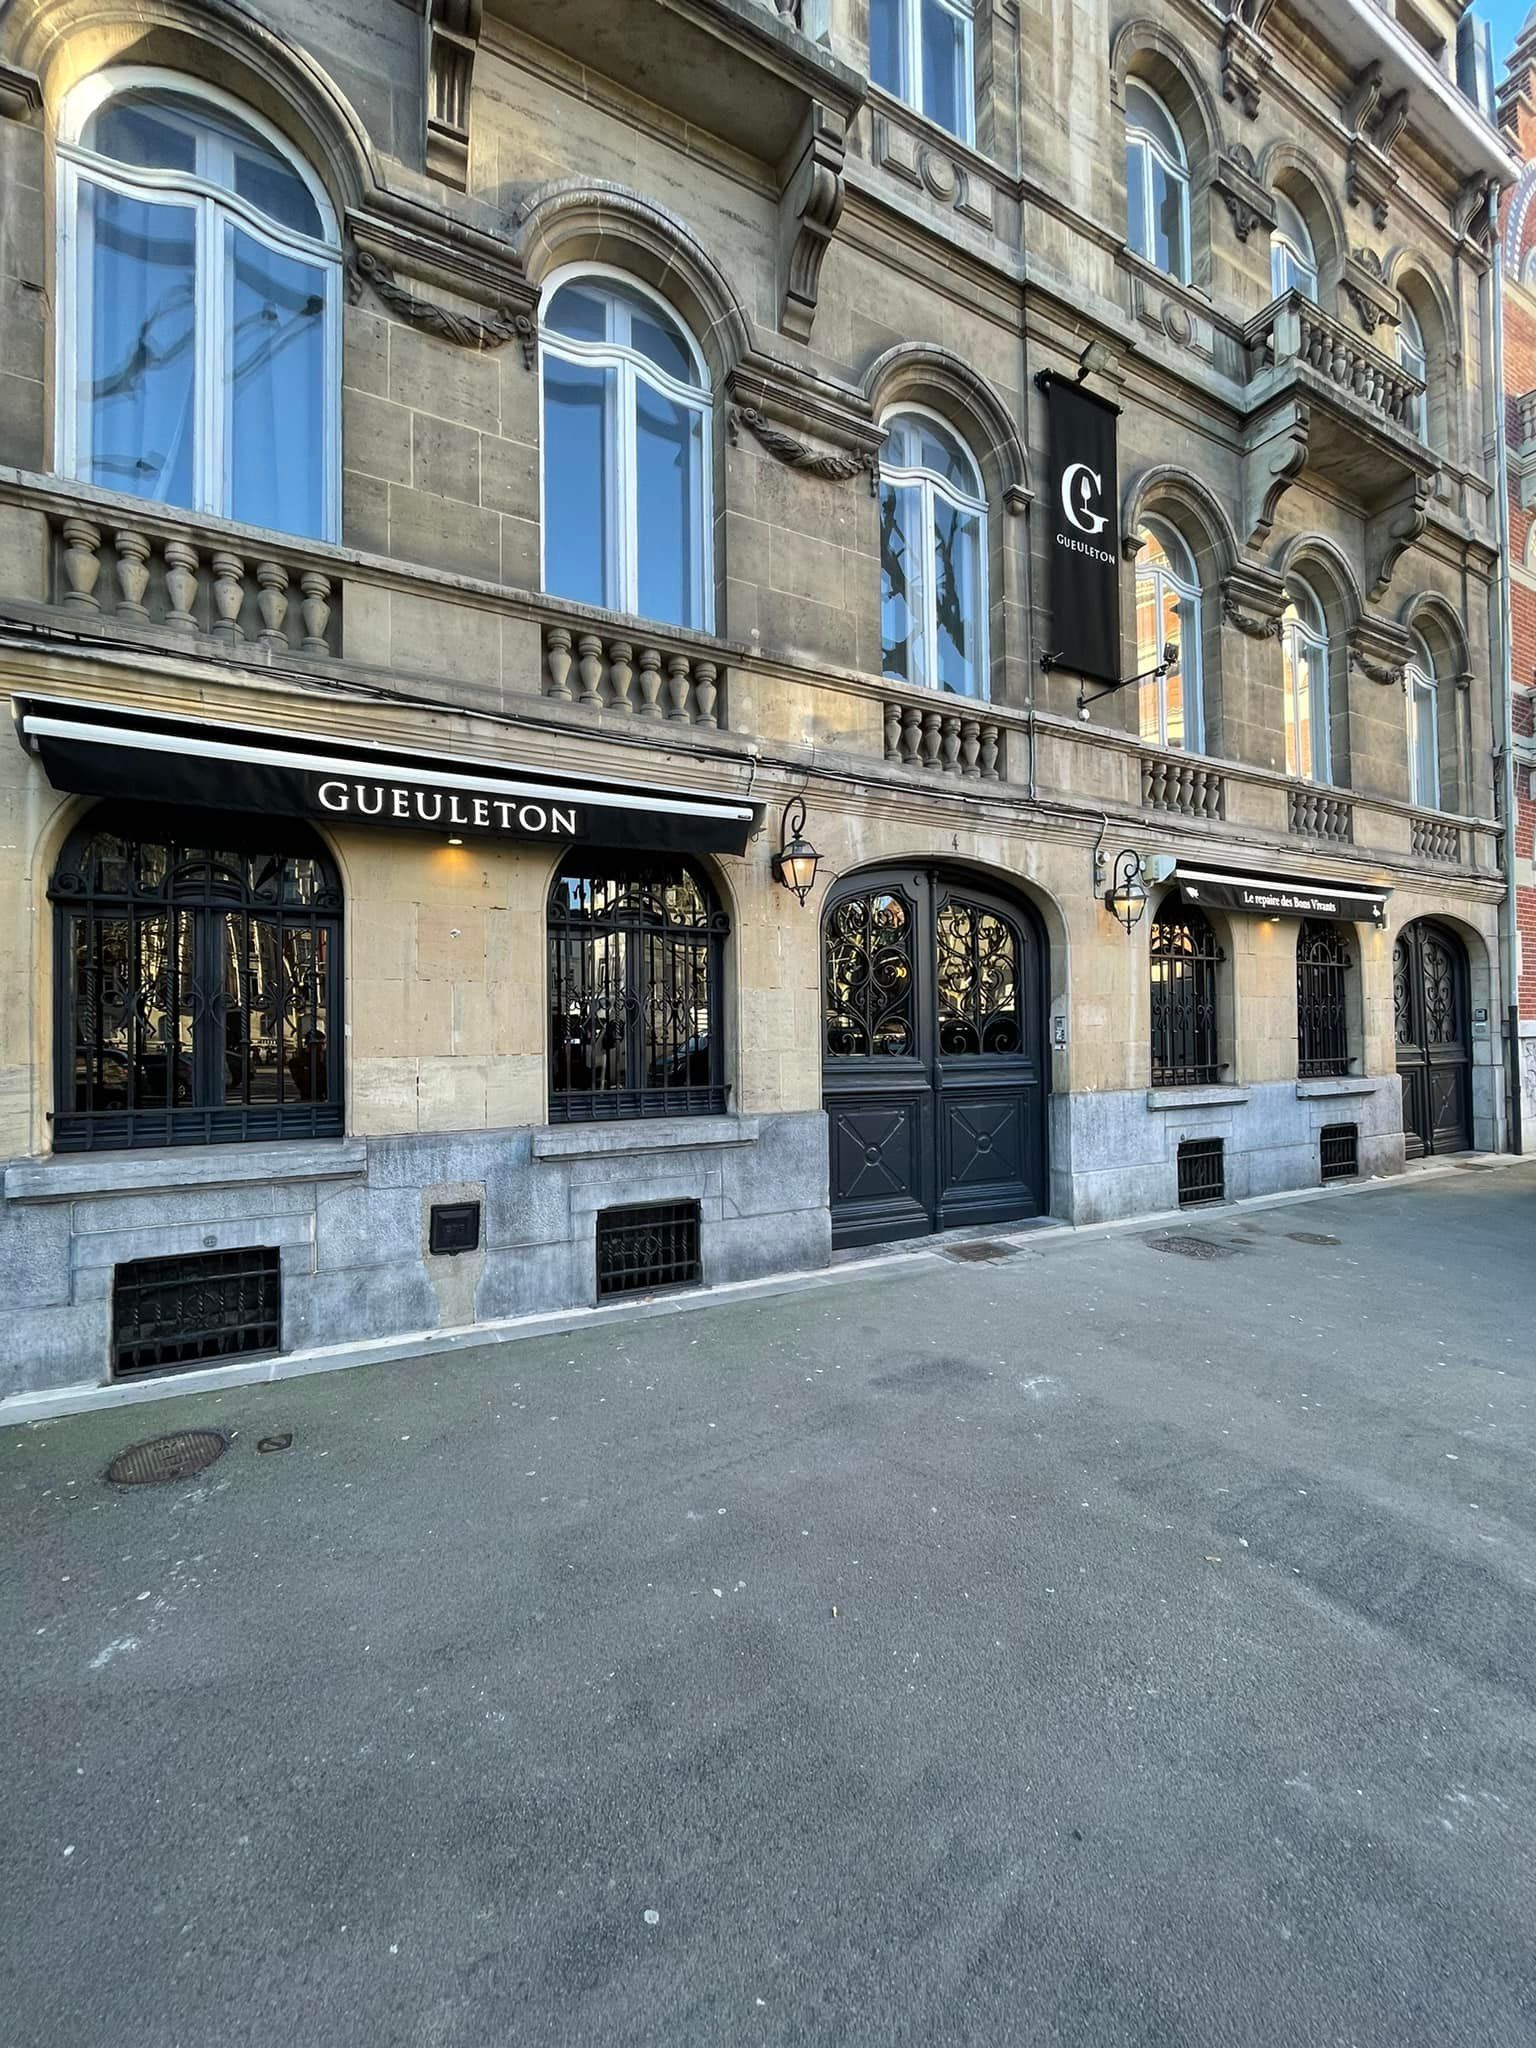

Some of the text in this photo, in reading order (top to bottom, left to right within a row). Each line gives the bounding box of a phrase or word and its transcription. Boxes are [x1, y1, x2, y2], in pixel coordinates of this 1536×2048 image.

[1056, 533, 1115, 565] GUEULETON
[317, 781, 577, 835] GUEULETON
[952, 833, 959, 850] 4
[1243, 891, 1336, 912] Le repaire des Bons Vivants
